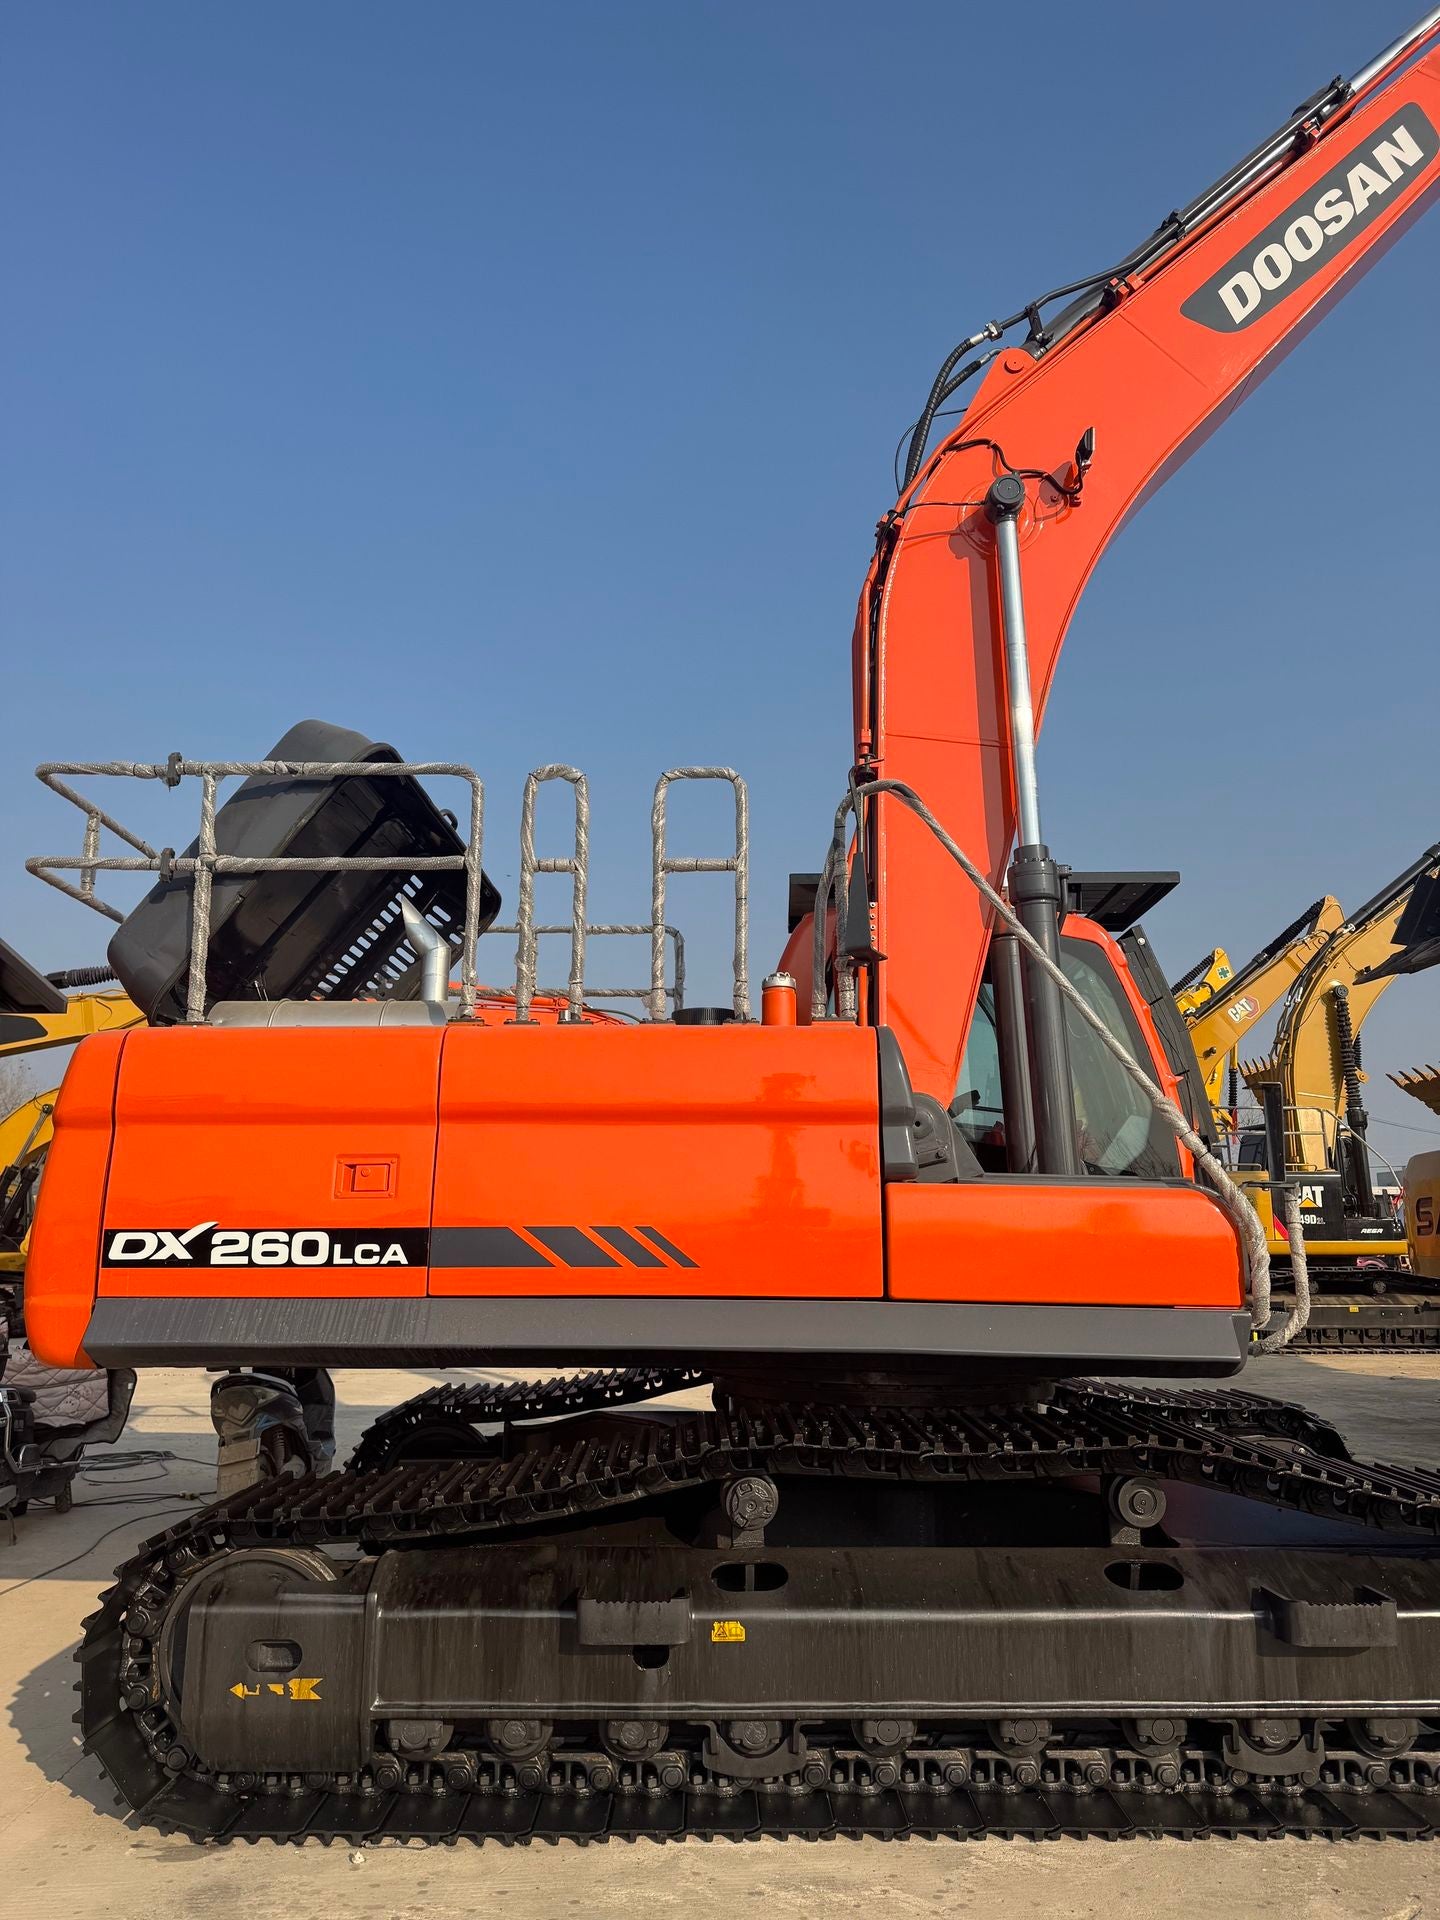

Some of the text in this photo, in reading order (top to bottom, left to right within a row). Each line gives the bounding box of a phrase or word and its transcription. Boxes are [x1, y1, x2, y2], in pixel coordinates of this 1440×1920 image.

[1217, 124, 1424, 325] DOOSAN
[1227, 998, 1252, 1022] CAT
[1298, 1185, 1325, 1208] AT
[1415, 1196, 1440, 1236] S
[108, 1221, 219, 1260] DX
